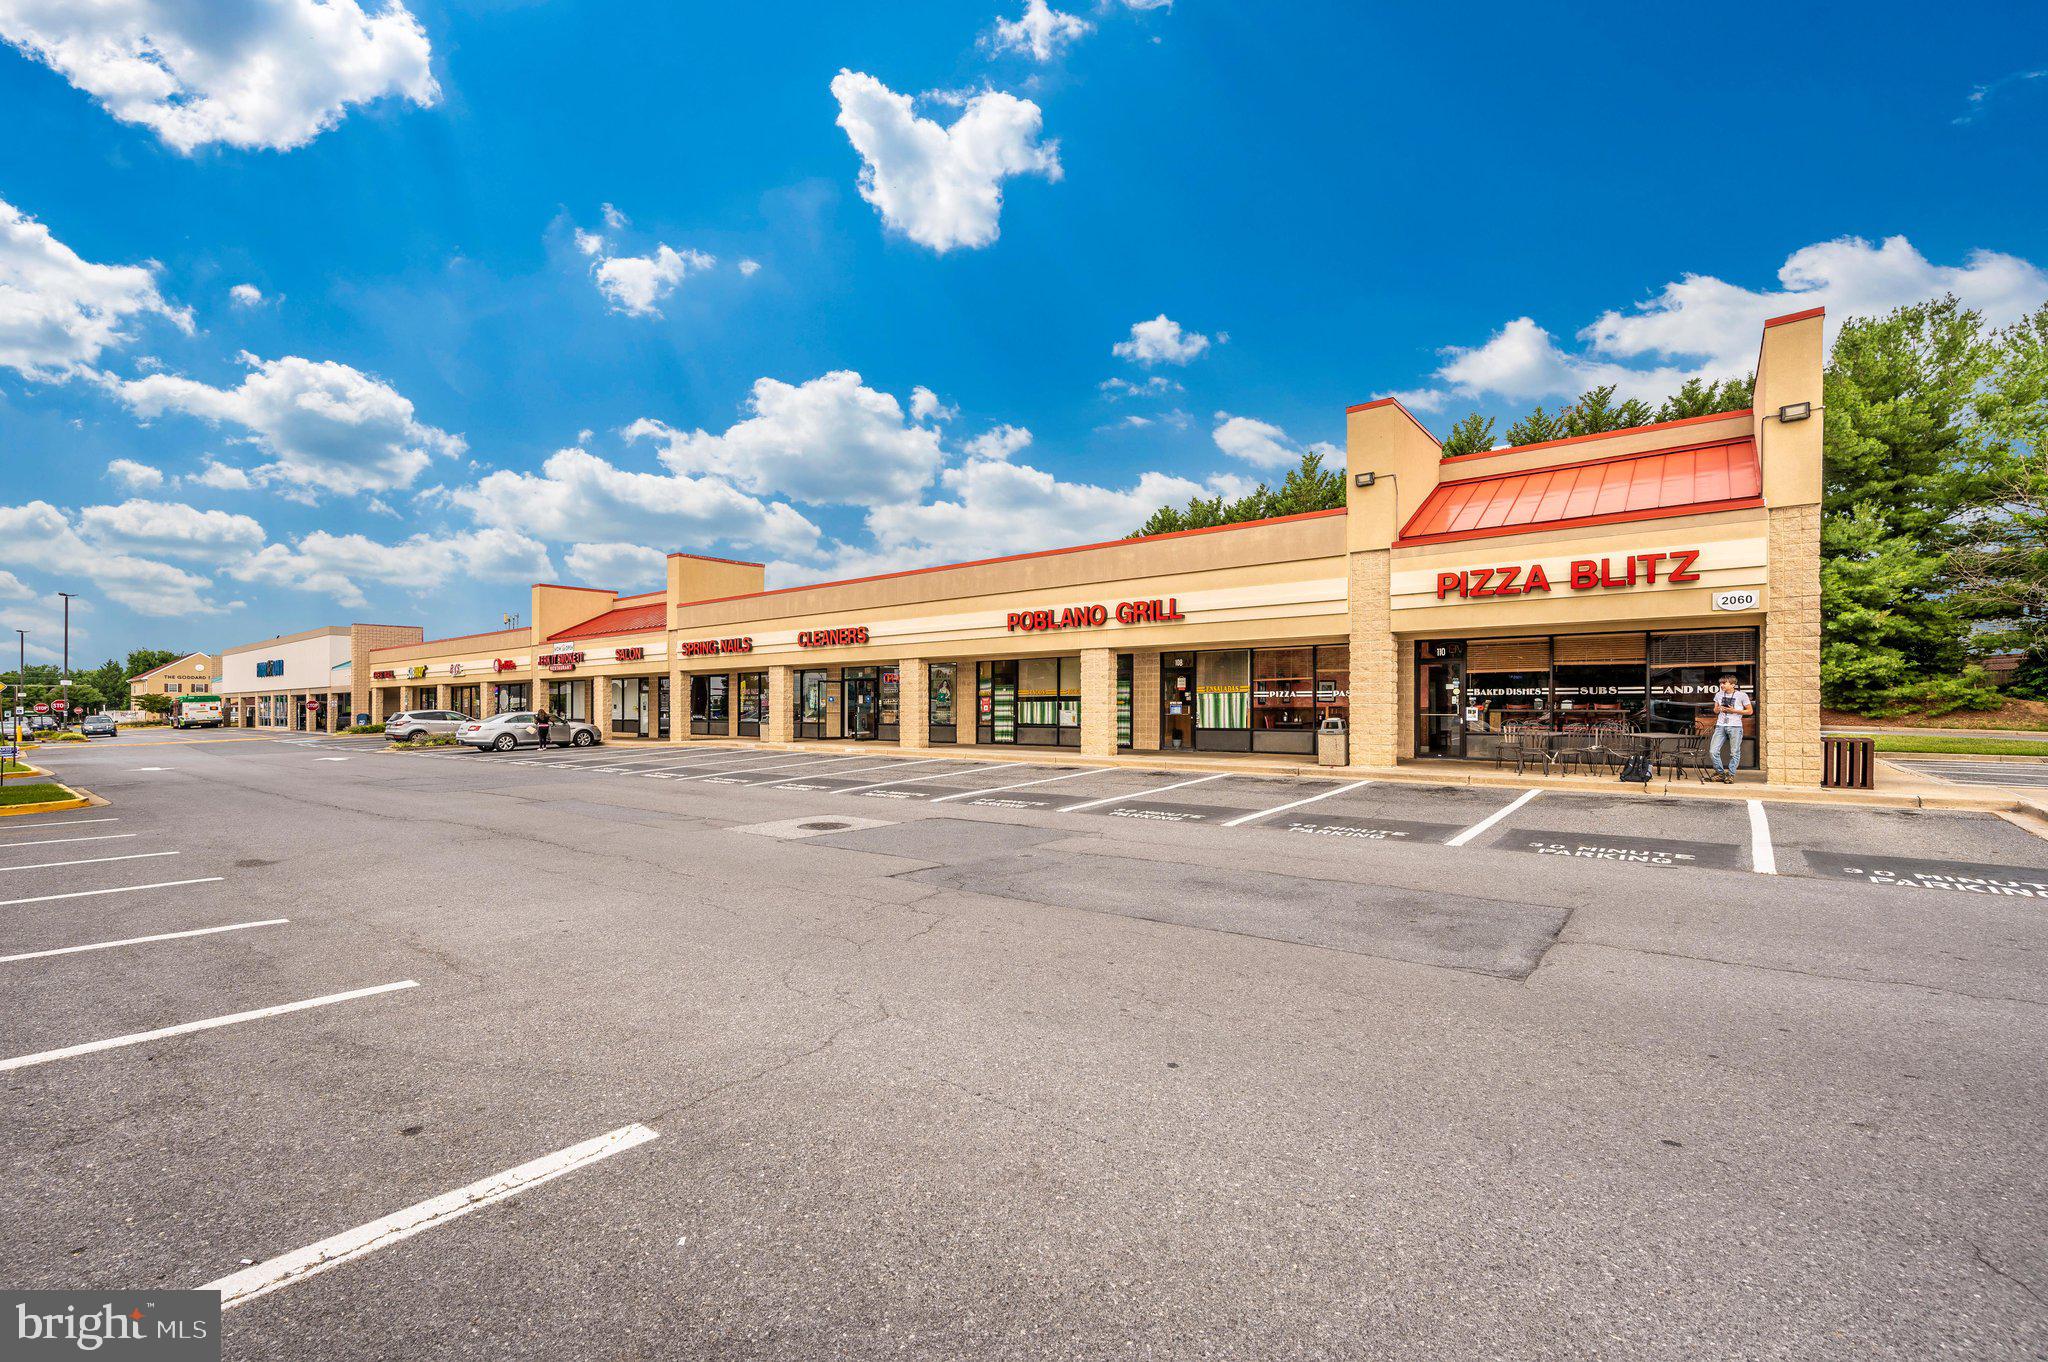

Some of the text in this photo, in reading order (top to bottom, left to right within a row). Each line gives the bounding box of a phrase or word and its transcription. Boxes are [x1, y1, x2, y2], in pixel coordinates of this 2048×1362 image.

[1437, 549, 1701, 600] PIZZA BLITZ
[1721, 594, 1753, 606] 2060
[1007, 597, 1184, 632] POBLANO GRILL
[797, 626, 869, 648] CLEANERS
[681, 636, 753, 657] SPRING NAILS
[1436, 647, 1446, 657] 110
[615, 646, 643, 661] SALON
[1204, 685, 1241, 693] ENSALADAS
[1269, 690, 1297, 698] PIZZA
[1473, 687, 1542, 696] BAKED DISHES
[1580, 686, 1618, 696] SUBS
[1663, 684, 1727, 695] AND MO
[306, 702, 319, 710] STOP
[1108, 811, 1184, 821] PARKING
[1287, 826, 1386, 839] PARKING
[1322, 825, 1411, 837] MINUTE
[1537, 847, 1673, 865] PARKING
[1576, 846, 1697, 861] MINUTE
[1842, 866, 1896, 877] 30
